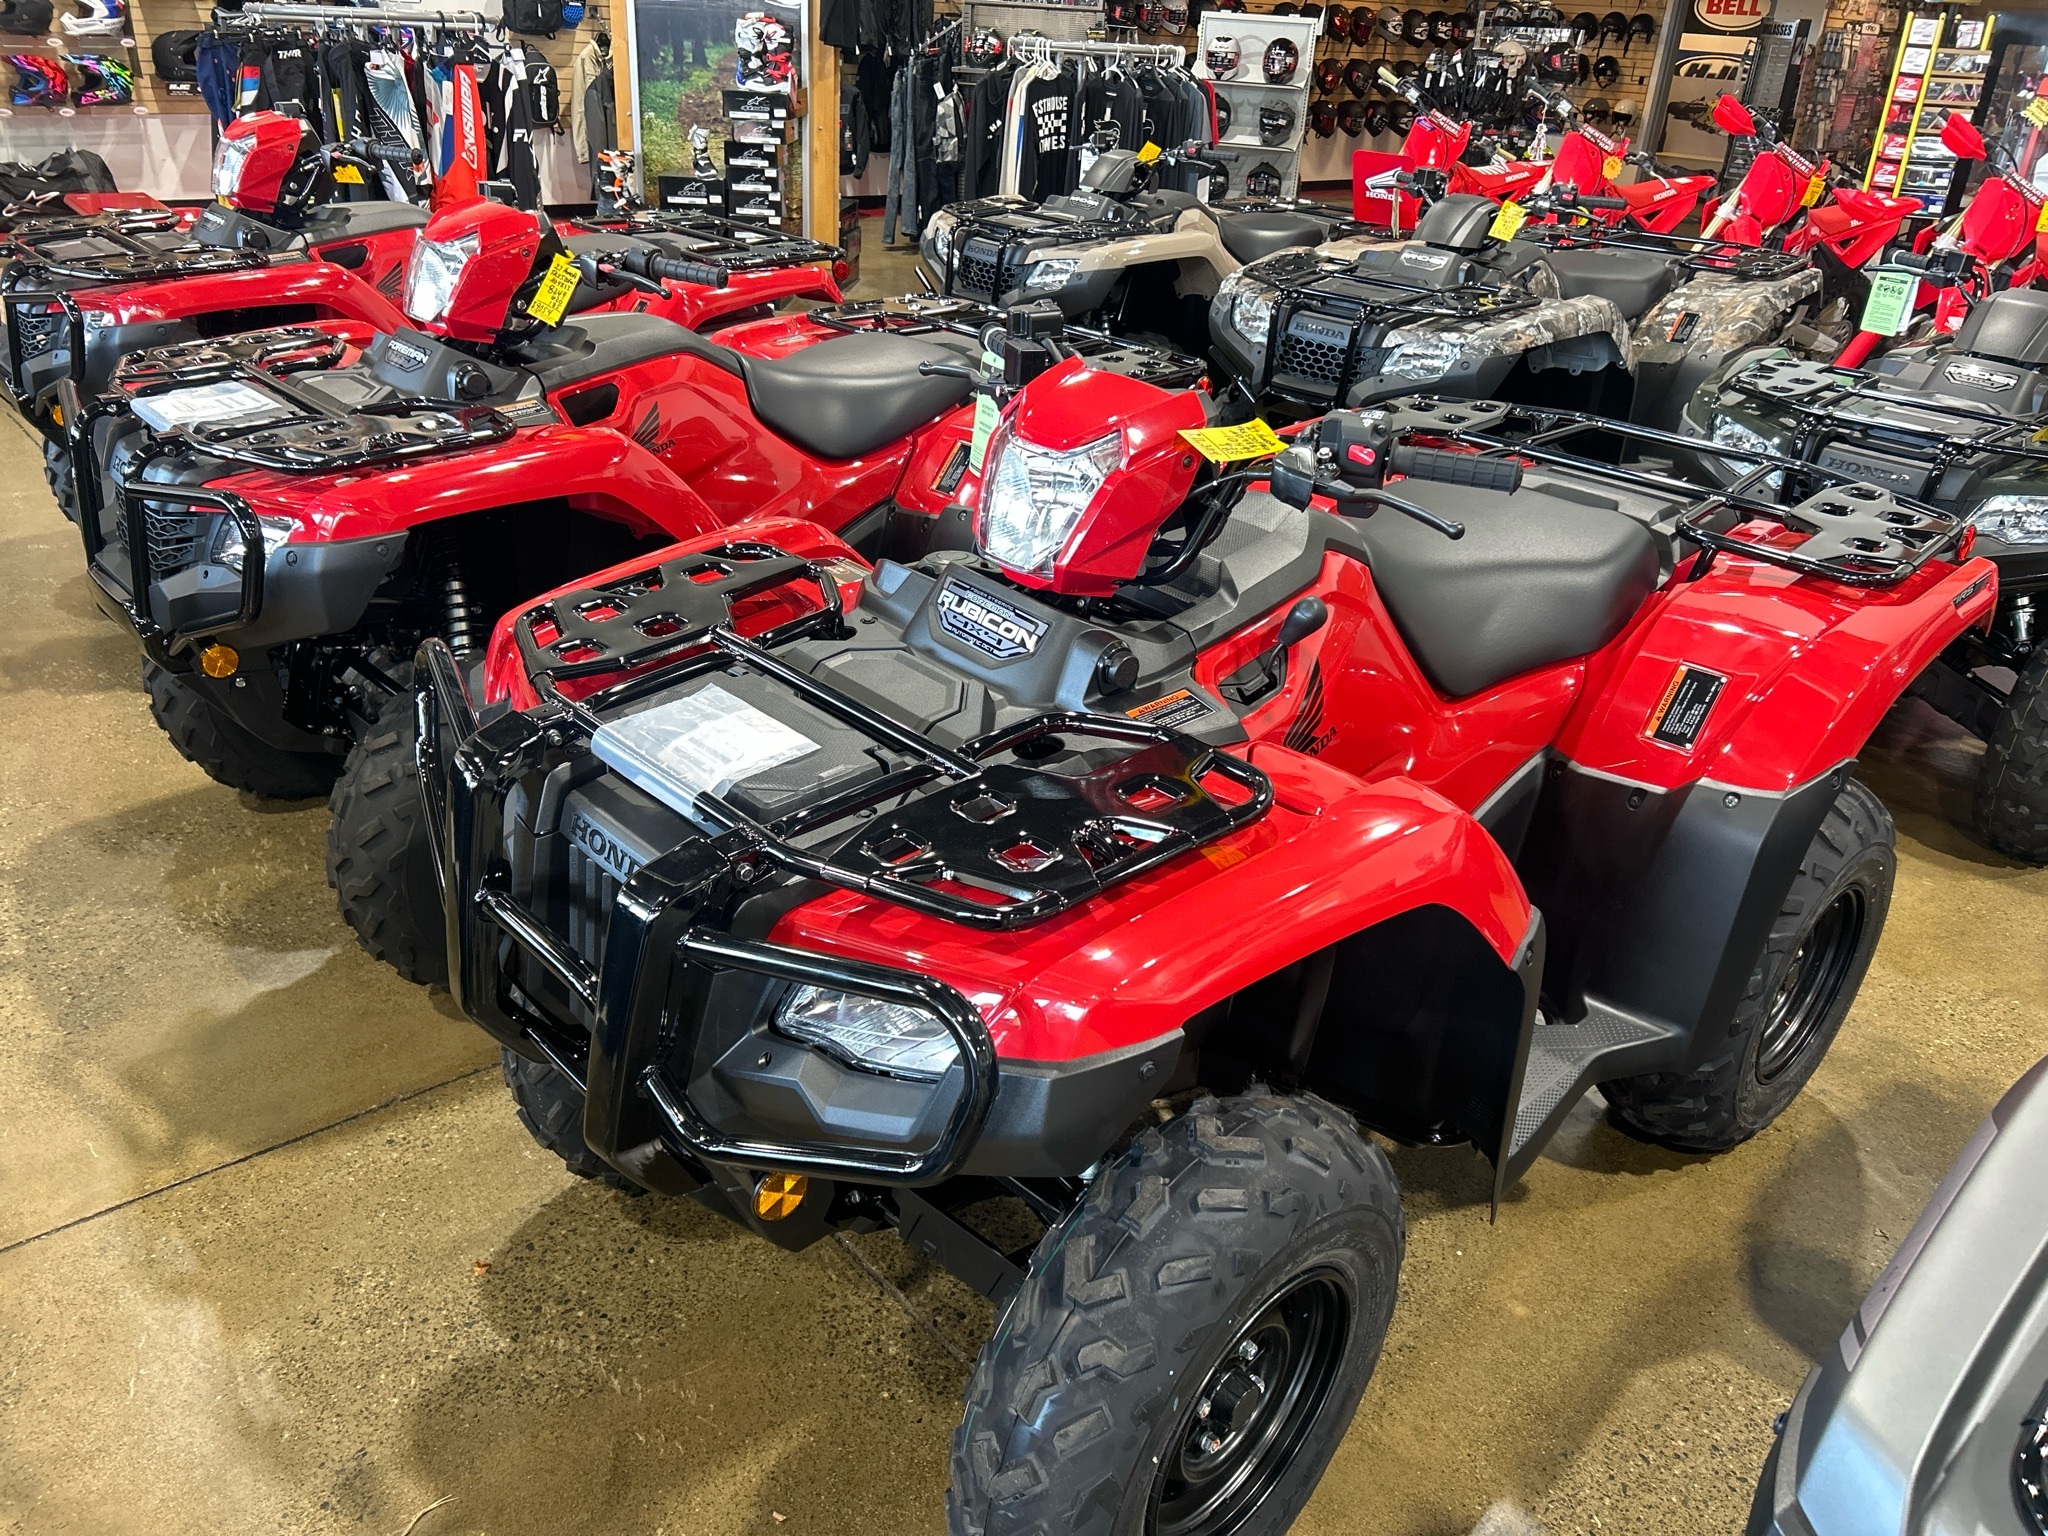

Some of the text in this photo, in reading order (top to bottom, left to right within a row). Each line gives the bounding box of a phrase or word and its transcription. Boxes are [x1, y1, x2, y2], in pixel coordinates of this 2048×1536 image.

[1705, 0, 1762, 16] BELL
[1294, 322, 1346, 340] HONDA
[388, 340, 428, 364] FOREMAN
[650, 438, 676, 456] NDA
[1828, 457, 1912, 487] HONDA
[965, 592, 1012, 619] FOREMAN
[970, 586, 1014, 611] POWER STEERING
[938, 588, 1039, 652] RUBICON
[951, 627, 994, 652] AUTOMATIC DCT
[1142, 694, 1180, 712] WARNING
[1659, 680, 1680, 714] WARNING
[1307, 725, 1338, 758] NDA
[570, 812, 642, 879] HOND
